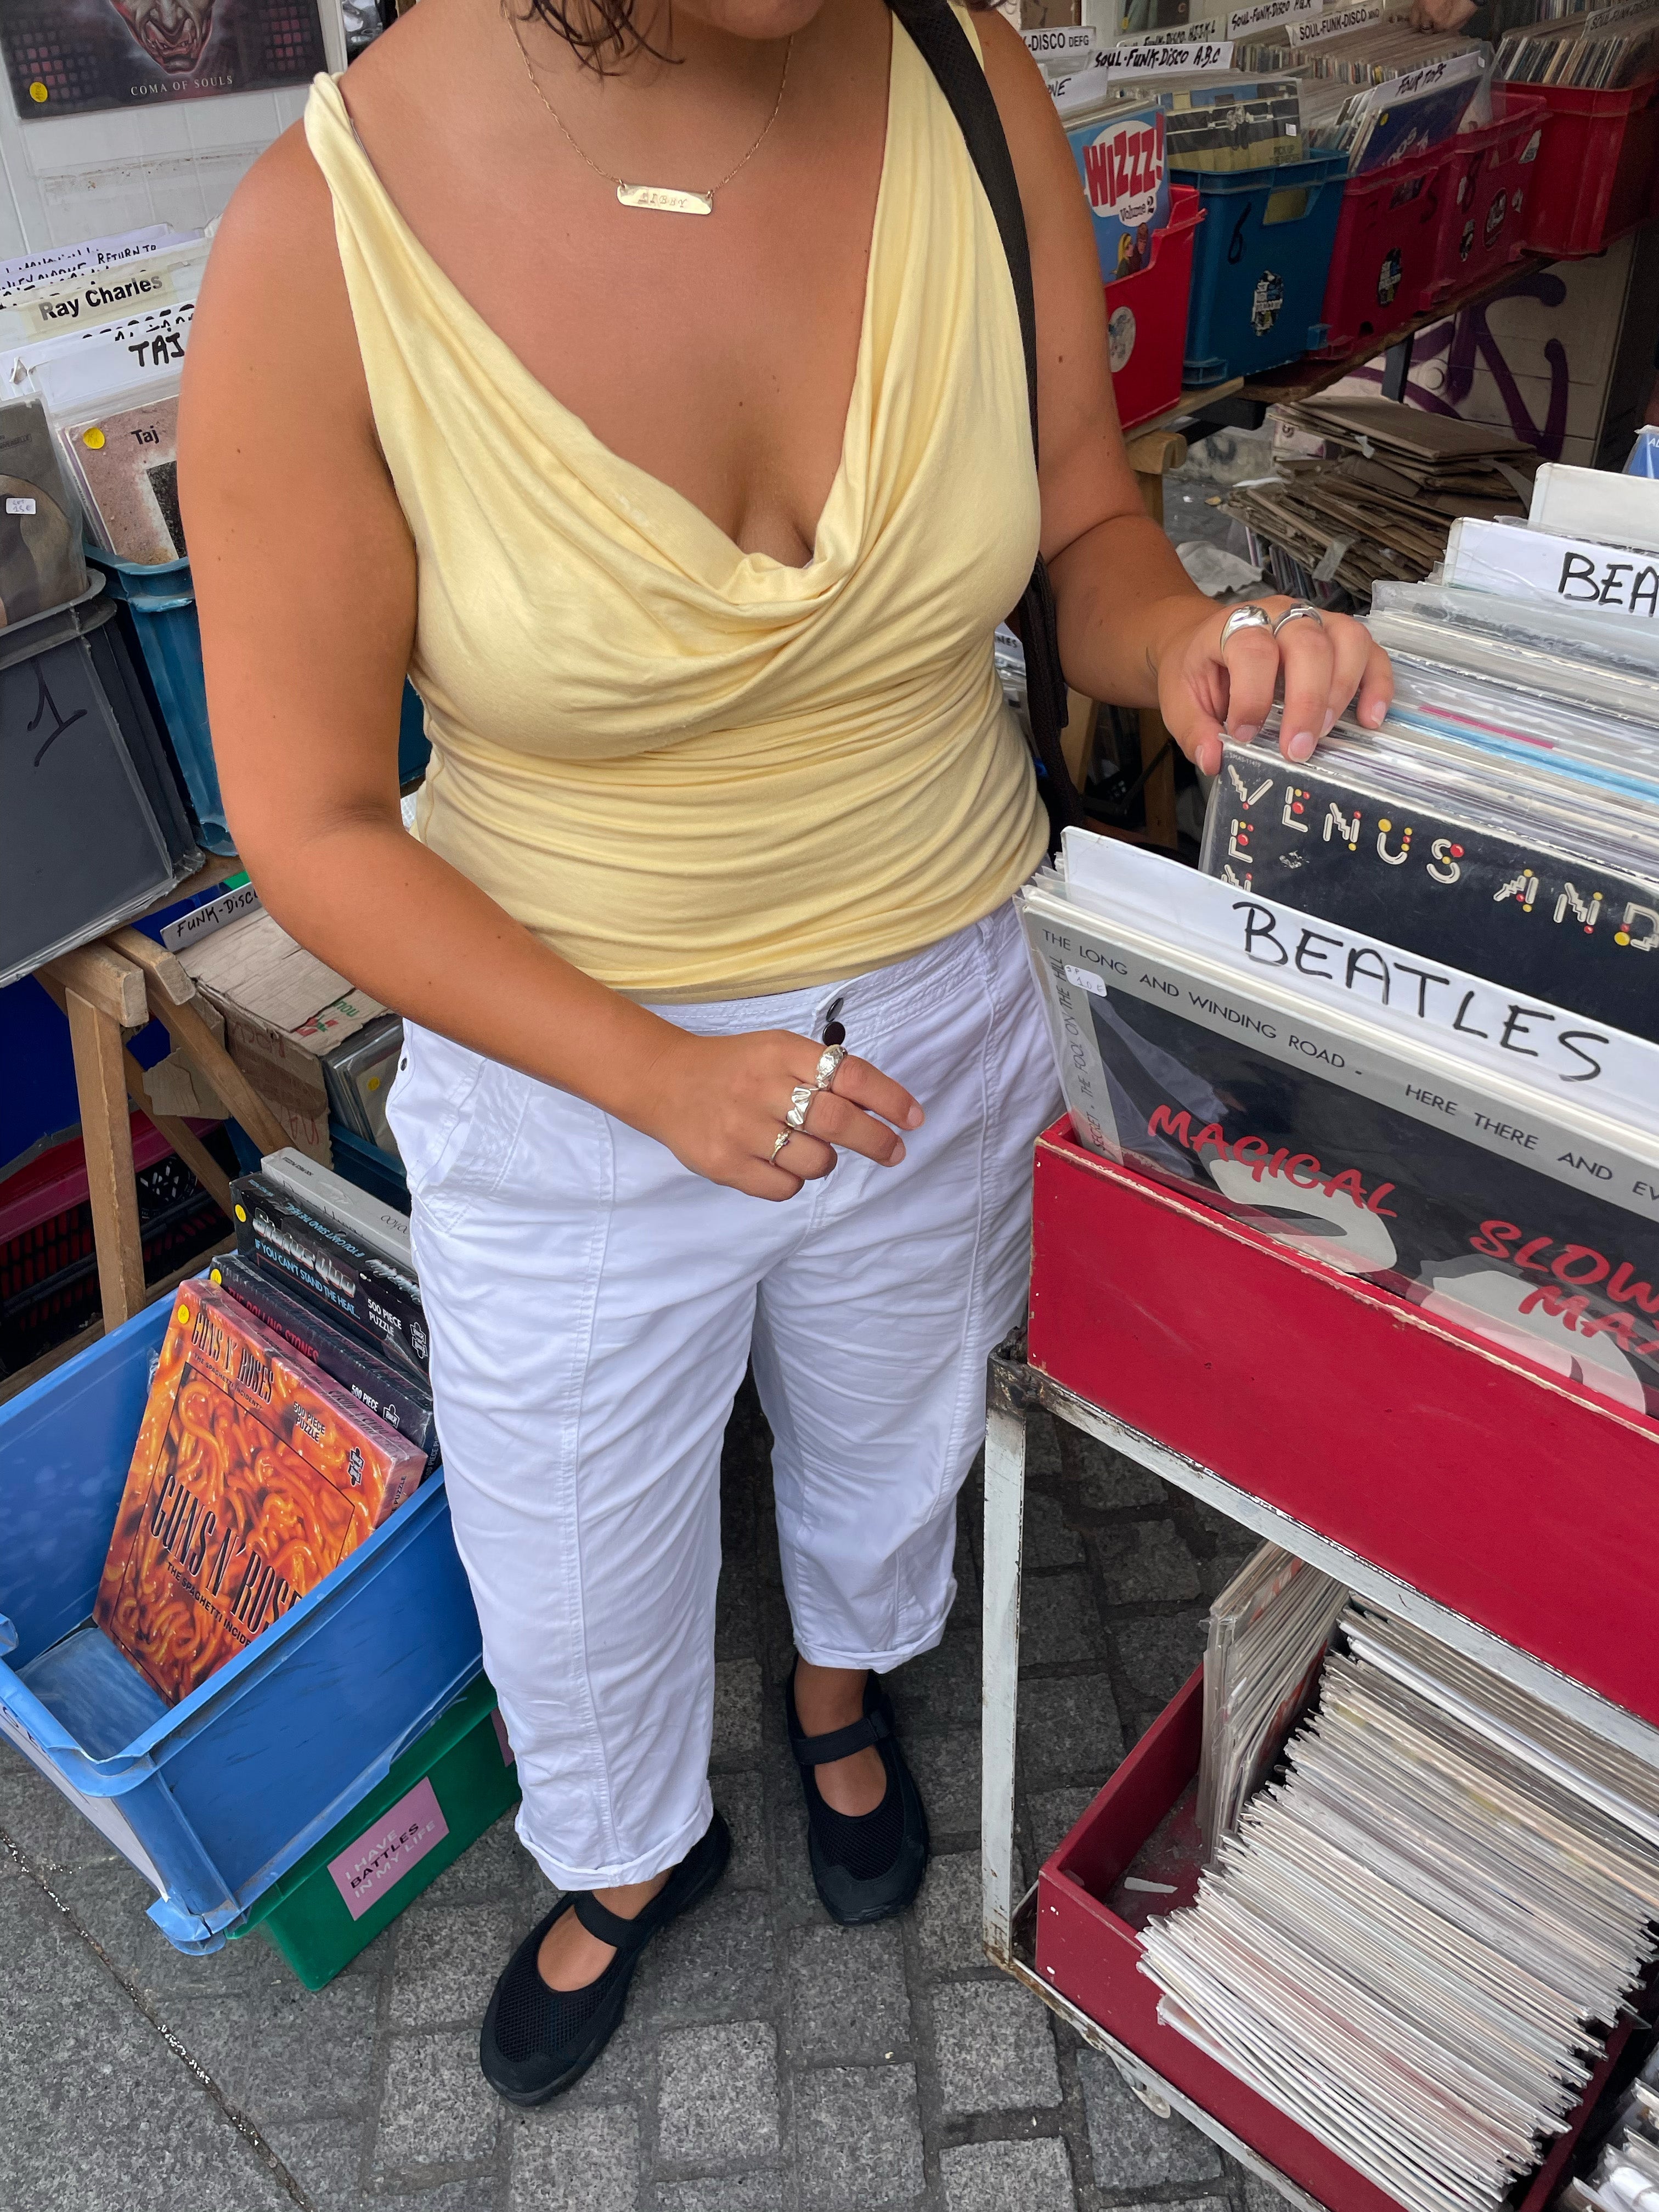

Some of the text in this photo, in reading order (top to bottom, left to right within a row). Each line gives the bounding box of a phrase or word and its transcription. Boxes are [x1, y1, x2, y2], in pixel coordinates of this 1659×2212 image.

[1069, 35, 1089, 47] DEFG
[131, 75, 233, 96] COMA OF SOULS
[1120, 196, 1155, 222] Volume 2
[38, 298, 79, 322] Ray
[85, 276, 162, 307] Charles
[131, 426, 160, 445] Taj
[1228, 765, 1659, 951] VENUS AND
[1049, 956, 1066, 982] HILL
[1056, 985, 1072, 1011] THE
[1232, 901, 1610, 1082] BEATLES
[1065, 1012, 1079, 1036] ON
[1042, 929, 1071, 951] THE
[1079, 945, 1127, 975] LONG
[1139, 973, 1180, 997] AND
[1189, 992, 1276, 1039] WINDING
[1289, 1035, 1345, 1068] ROAD
[1405, 1084, 1458, 1115] HERE
[1474, 1112, 1539, 1150] THERE
[1558, 1152, 1612, 1181] AND
[1081, 1077, 1093, 1097] THE
[1147, 1104, 1398, 1218] MAGICAL
[252, 1207, 315, 1270] Status
[315, 1250, 356, 1298] Quo
[255, 1238, 262, 1249] IF
[262, 1244, 277, 1261] YOU
[278, 1255, 298, 1276] CAN'T
[300, 1269, 323, 1291] STAND
[323, 1285, 336, 1302] THE
[368, 1298, 402, 1330] 500 PIECE
[369, 1311, 394, 1336] PUZZLE
[192, 1312, 223, 1363] GUNS
[237, 1347, 274, 1405] ROSES
[194, 1353, 263, 1411] THE SPAGHETTI INCIDENT?
[351, 1384, 379, 1412] 500 PIECE
[294, 1401, 306, 1419] 500
[307, 1414, 325, 1435] PIECE
[296, 1417, 319, 1443] PUZZLE
[394, 1476, 407, 1504] PUZZLE
[151, 1474, 217, 1577] GUNS
[230, 1550, 302, 1634] ROS
[166, 1561, 251, 1646] THE SPAGHETTI INCIDE
[345, 1830, 398, 1880] I HAVE
[351, 1823, 419, 1889] BATTLES
[354, 1820, 435, 1898] IN MY LIFE
